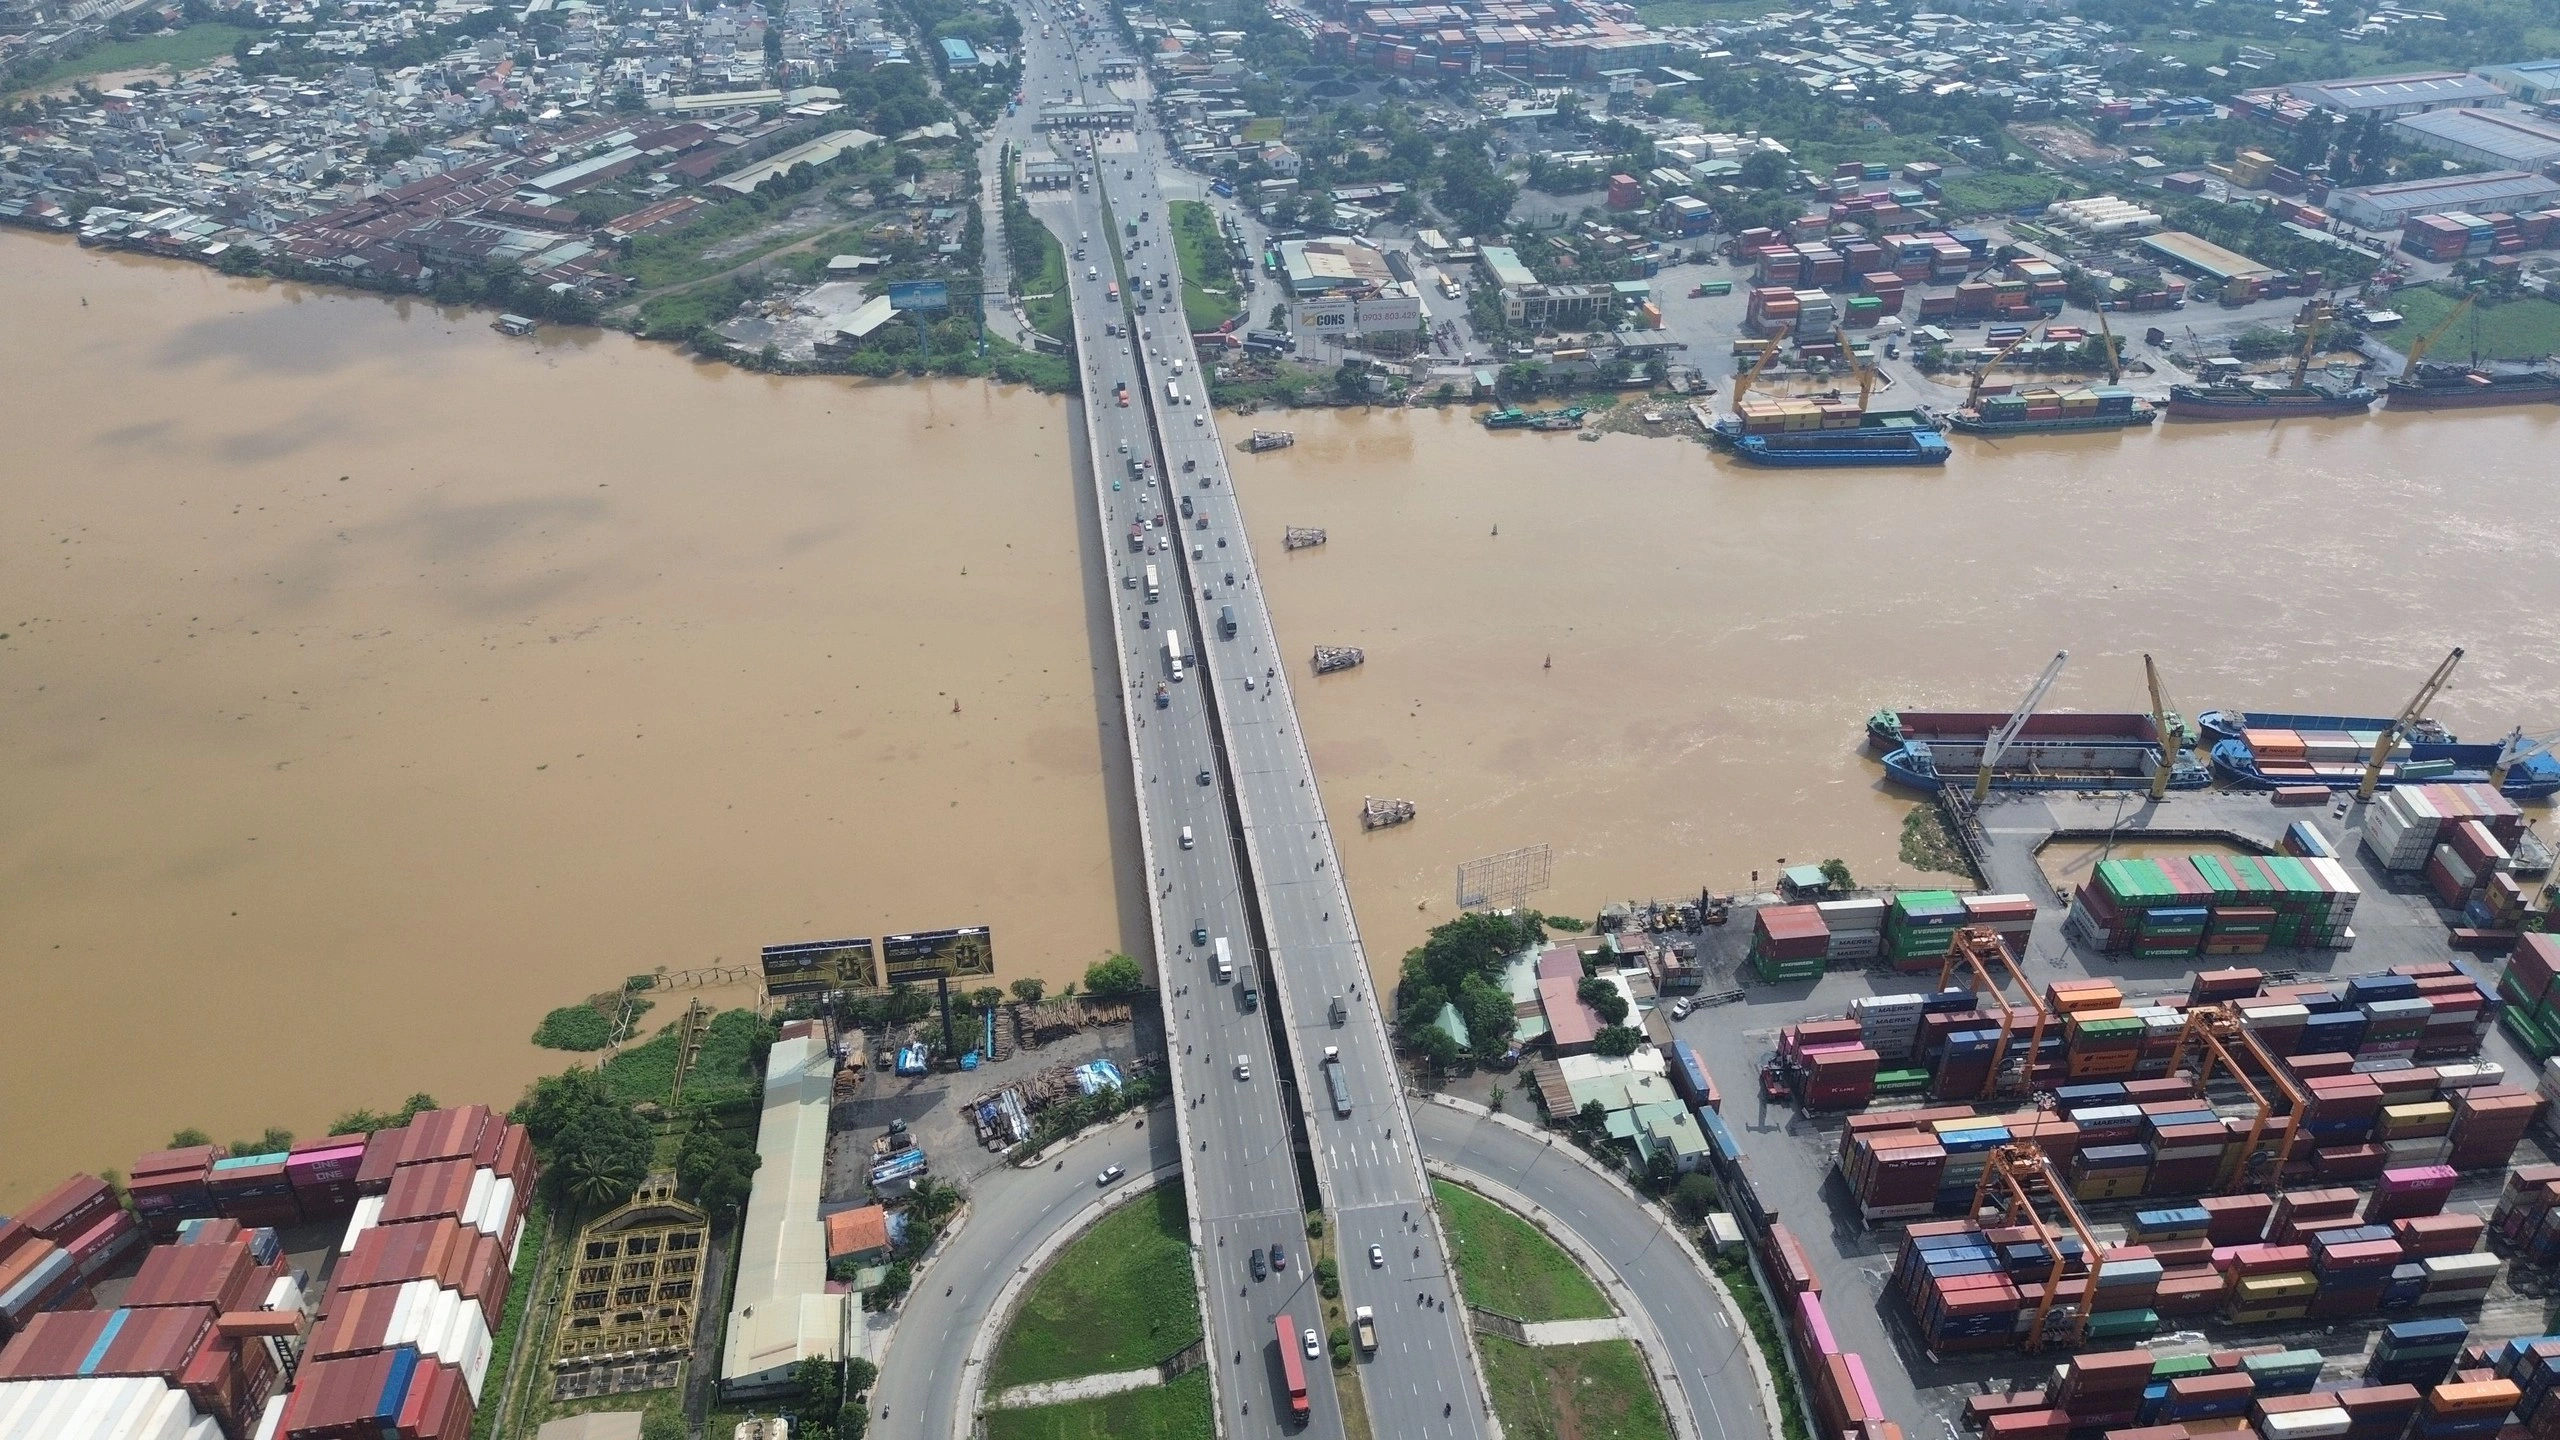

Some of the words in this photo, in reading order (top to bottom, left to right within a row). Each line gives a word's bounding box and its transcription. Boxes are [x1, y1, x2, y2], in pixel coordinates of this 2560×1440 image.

[1317, 313, 1345, 326] CONS
[1928, 917, 1943, 925] APL
[1912, 927, 1956, 935] EVERGREEN
[1840, 937, 1873, 945] MAERSK
[1781, 960, 1814, 968] EVERGREEN
[1779, 971, 1813, 979] EVERGREEN
[1878, 1005, 1915, 1013] MAERSK
[1875, 1016, 1913, 1025] MAERSK
[2378, 1042, 2400, 1050] ONE
[1876, 1081, 1922, 1089] EVERGREEN
[2092, 1118, 2132, 1127] MAERSK
[312, 1159, 339, 1170] ONE
[315, 1170, 344, 1181] ONE
[2410, 1179, 2434, 1188] ONE
[87, 1245, 97, 1254] K
